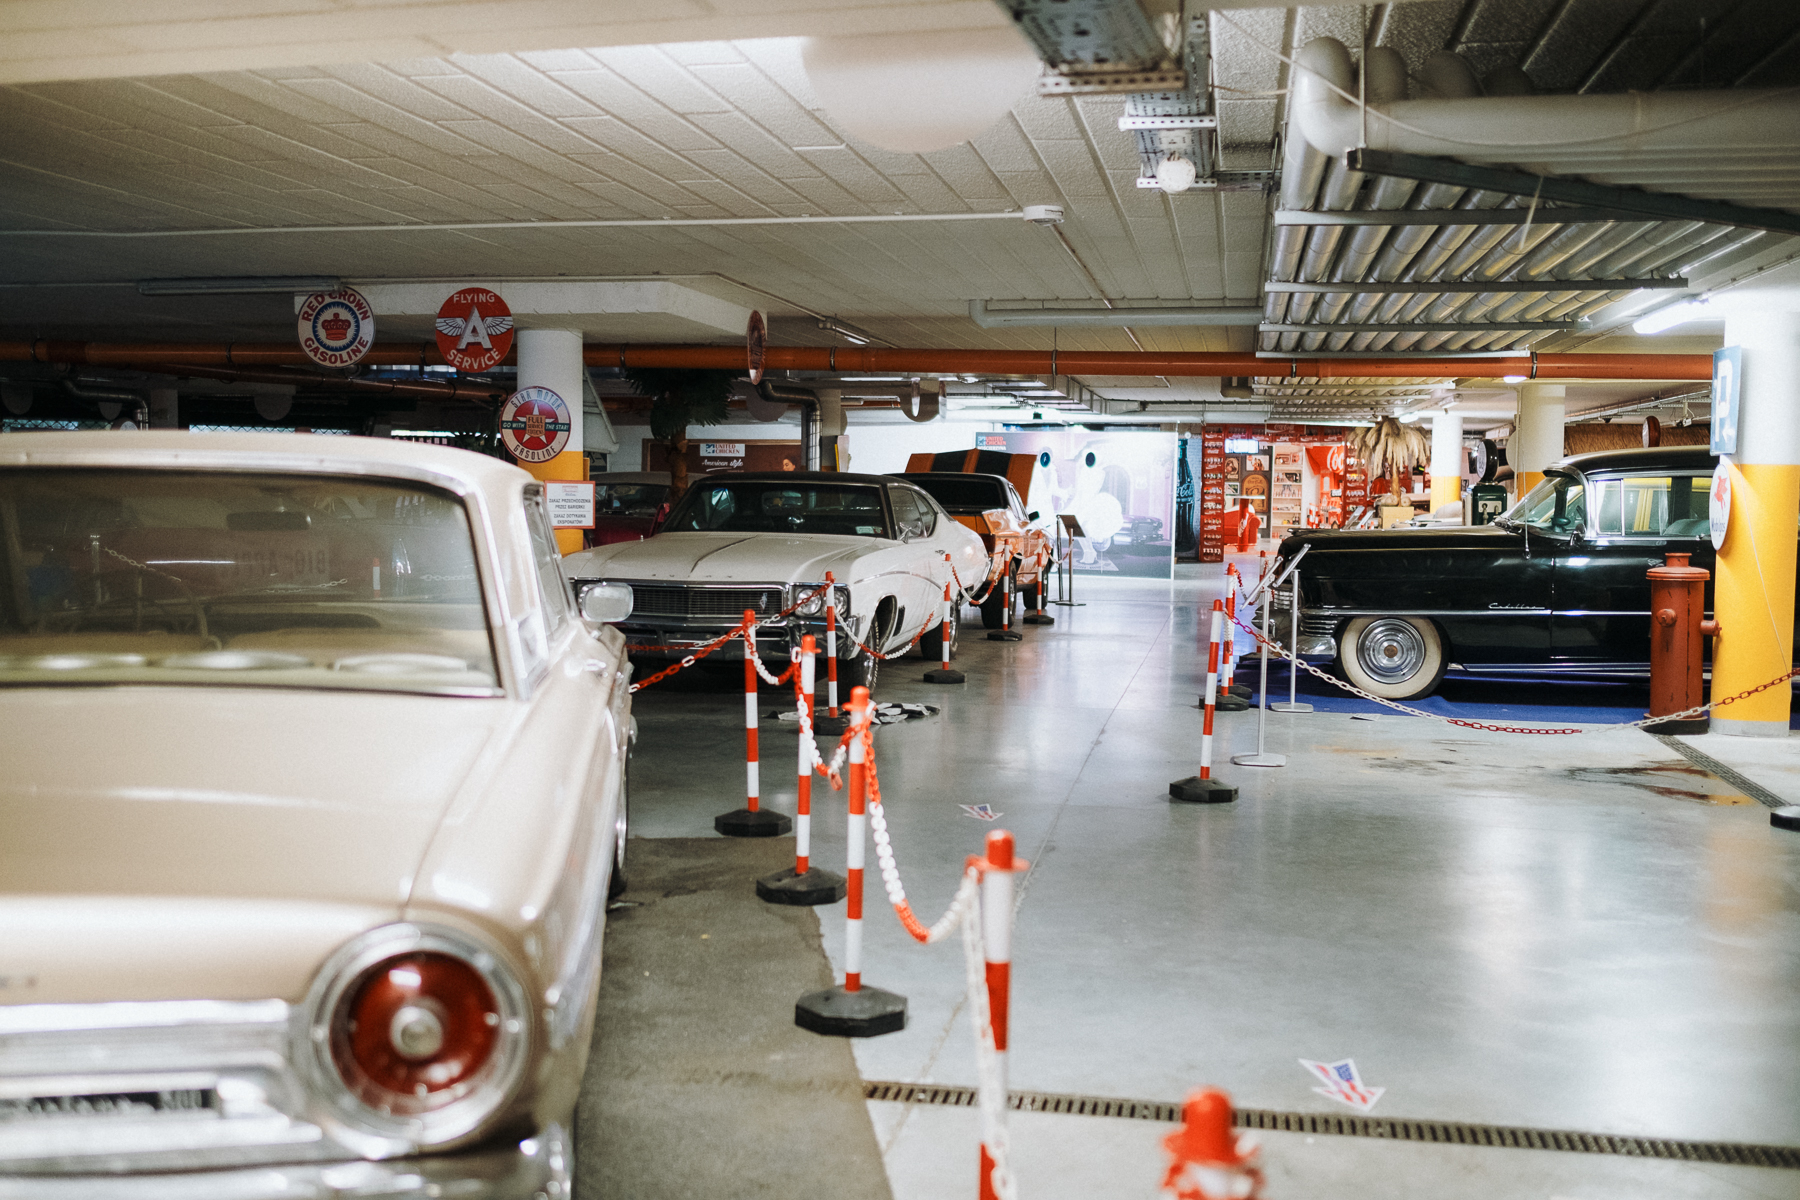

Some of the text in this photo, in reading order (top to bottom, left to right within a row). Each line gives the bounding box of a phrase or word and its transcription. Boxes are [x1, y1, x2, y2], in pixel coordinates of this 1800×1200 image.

[302, 290, 370, 322] RED CROWN
[453, 292, 495, 304] FLYING
[456, 305, 493, 350] A
[304, 336, 369, 364] GASOLINE
[447, 348, 501, 370] SERVICE
[511, 389, 562, 411] STAR MOTOR
[1715, 358, 1733, 442] P
[527, 416, 544, 424] FULL
[513, 444, 557, 461] GASOLINE
[702, 458, 744, 469] American style
